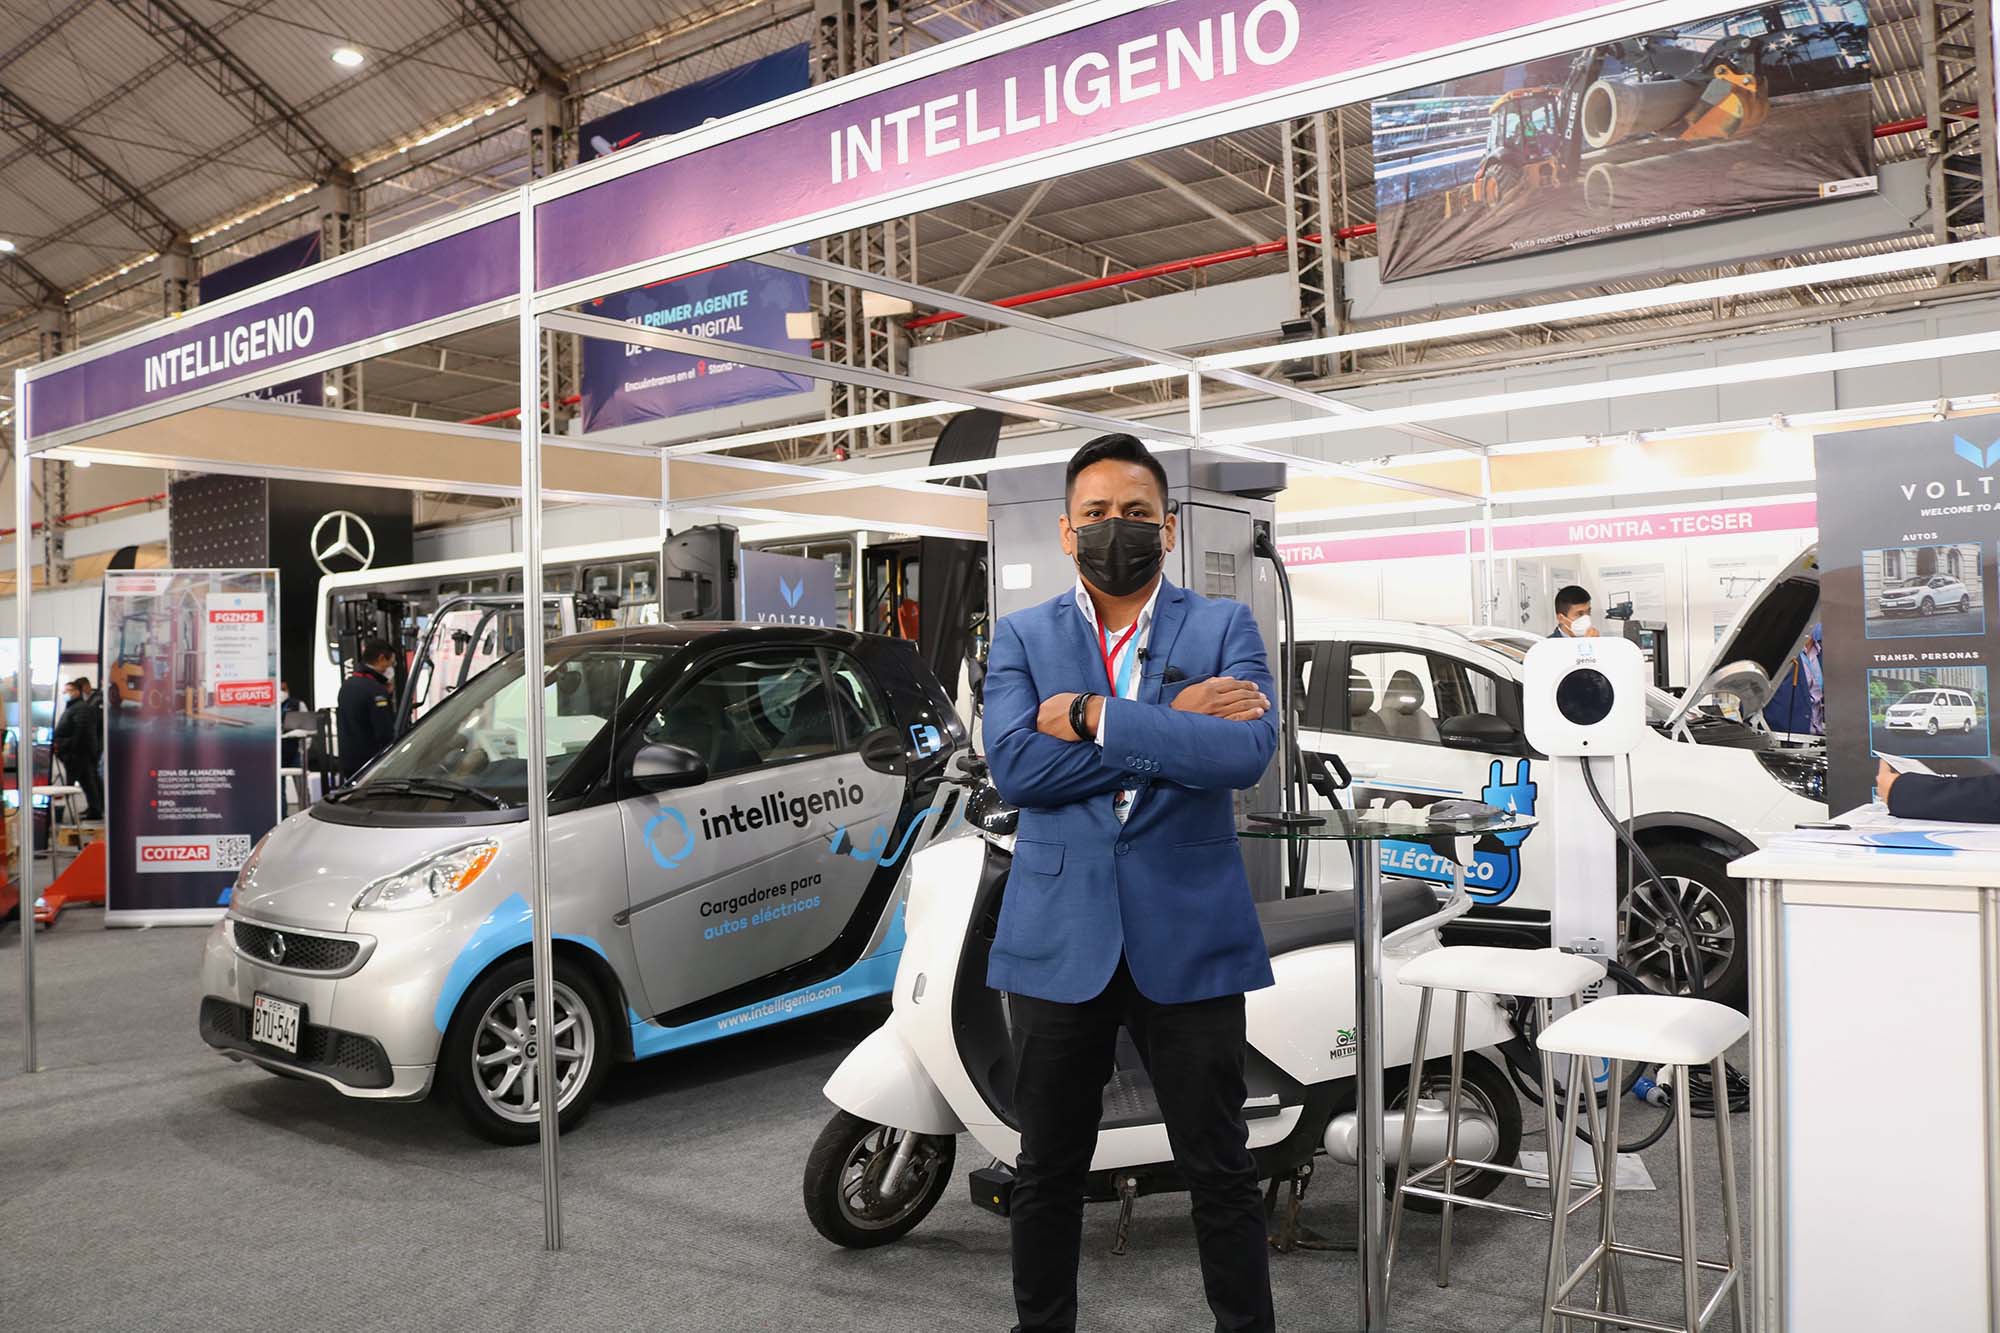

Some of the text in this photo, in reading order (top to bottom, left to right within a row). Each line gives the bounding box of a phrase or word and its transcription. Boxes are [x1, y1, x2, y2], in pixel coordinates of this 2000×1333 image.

[829, 0, 1300, 185] INTELLIGENIO
[644, 304, 692, 327] PRIMER
[694, 290, 749, 317] AGENTE
[692, 315, 743, 337] DIGITAL
[144, 306, 315, 393] INTELLIGENIO
[1921, 505, 1974, 517] WELCOME
[1976, 503, 1992, 512] TO
[1568, 520, 1653, 542] MONTRA
[1670, 512, 1753, 533] TECSER
[1902, 532, 1938, 542] AUTOS
[1259, 566, 1267, 582] A
[1873, 651, 1980, 662] TRANSP. PERSONAS
[700, 777, 864, 841] intelligenio
[144, 847, 208, 860] COTIZAR
[1380, 847, 1494, 880] ELÉCTRCO
[700, 873, 822, 917] Cargadores para
[703, 895, 821, 940] autos eléctricos
[717, 983, 842, 1031] www.intelligenio.com
